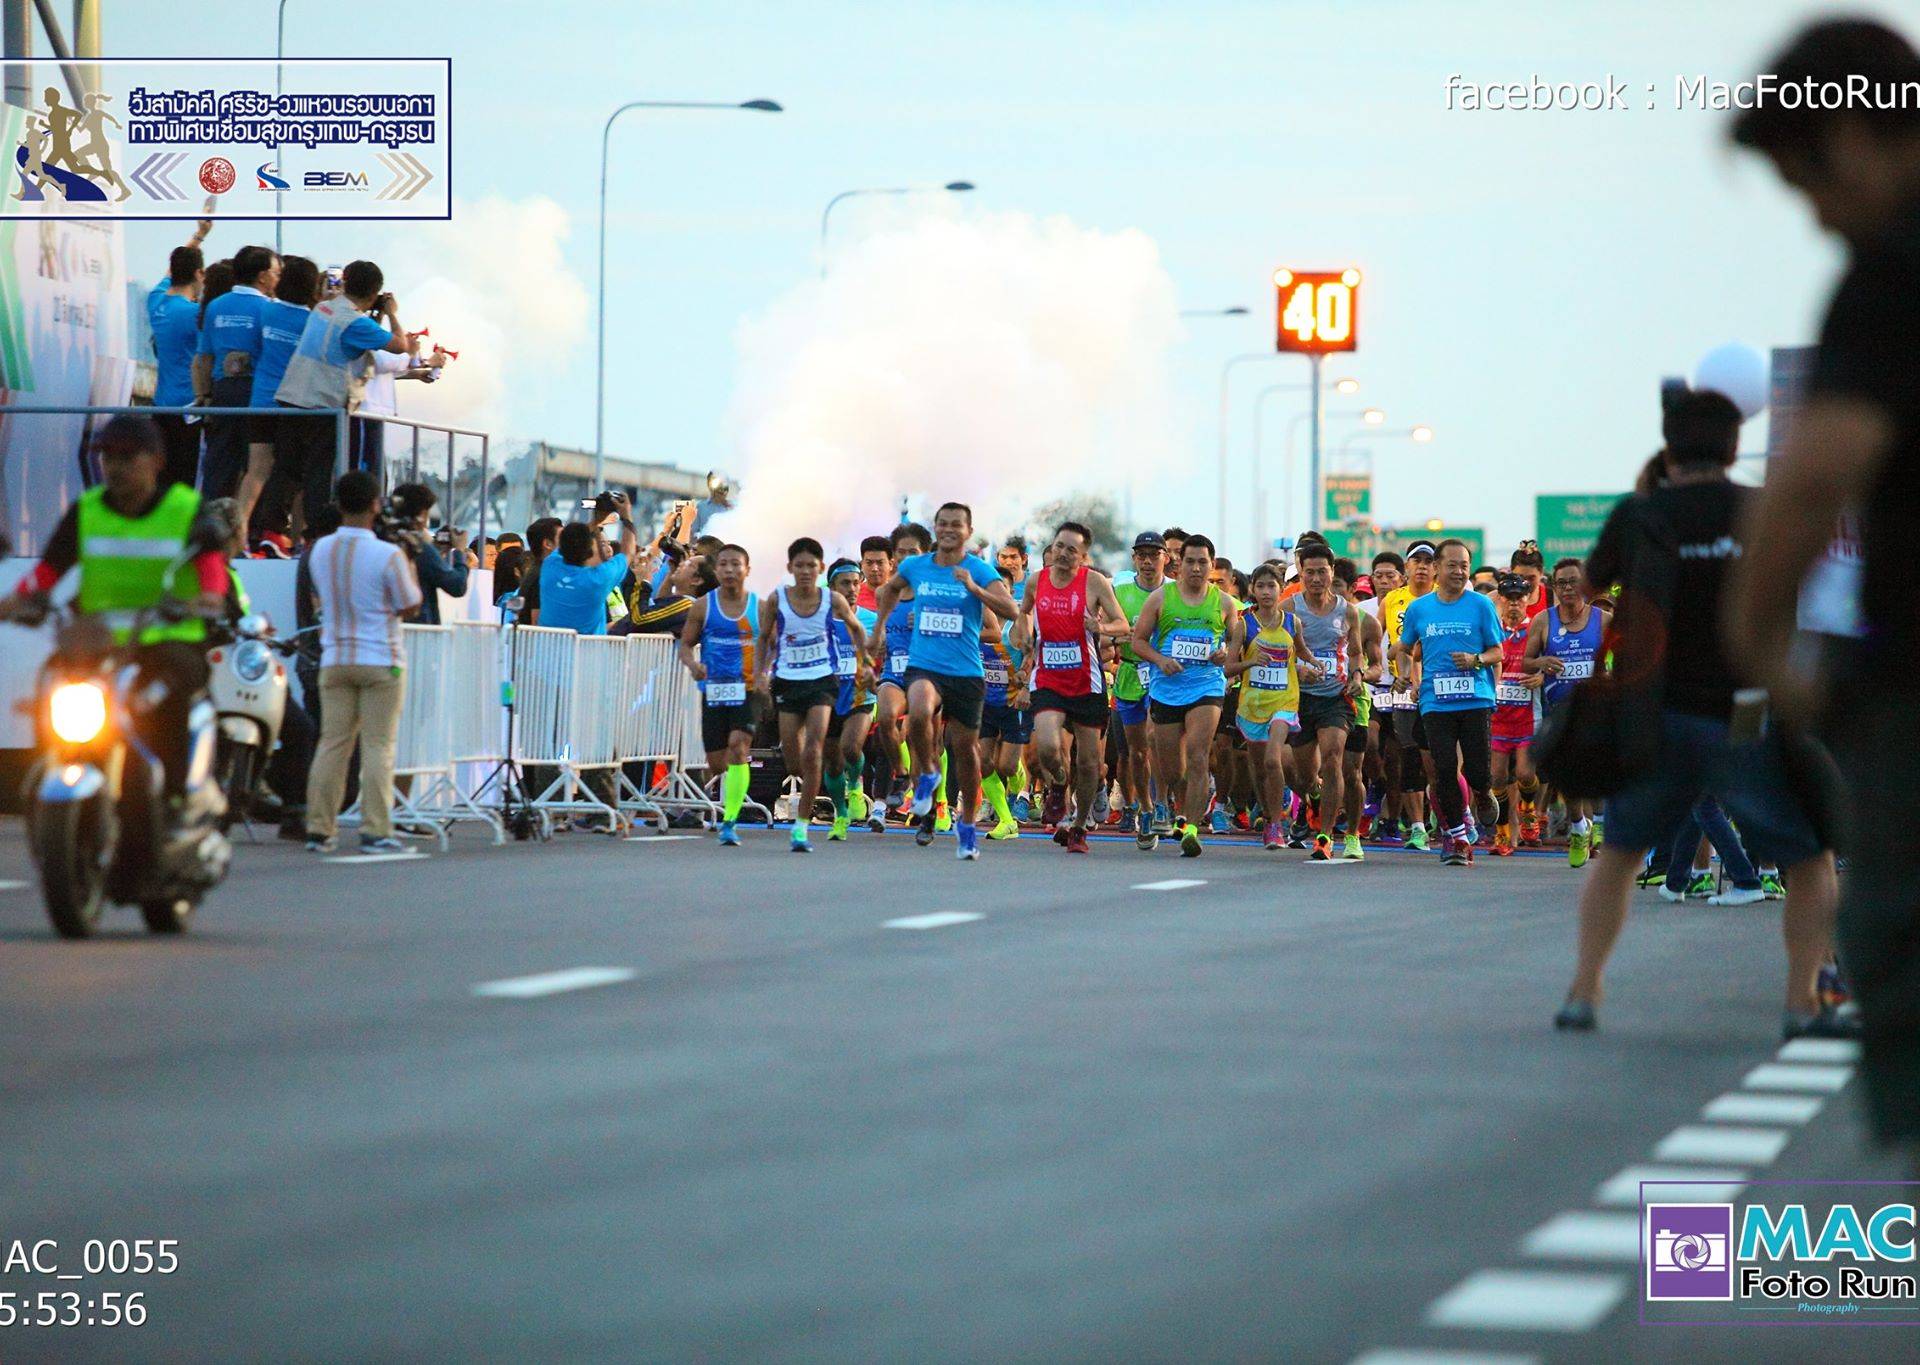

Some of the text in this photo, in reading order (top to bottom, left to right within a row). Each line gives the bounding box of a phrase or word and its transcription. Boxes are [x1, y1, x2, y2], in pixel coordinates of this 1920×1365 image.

[1283, 282, 1350, 341] 40
[925, 615, 958, 631] 1665
[791, 646, 821, 660] 1731
[1046, 650, 1077, 662] 2050
[1176, 644, 1206, 658] 2004
[1258, 669, 1279, 682] 911
[1560, 663, 1590, 677] 2281
[713, 685, 737, 698] 968
[1438, 679, 1470, 692] 1149
[1500, 687, 1528, 699] 1523
